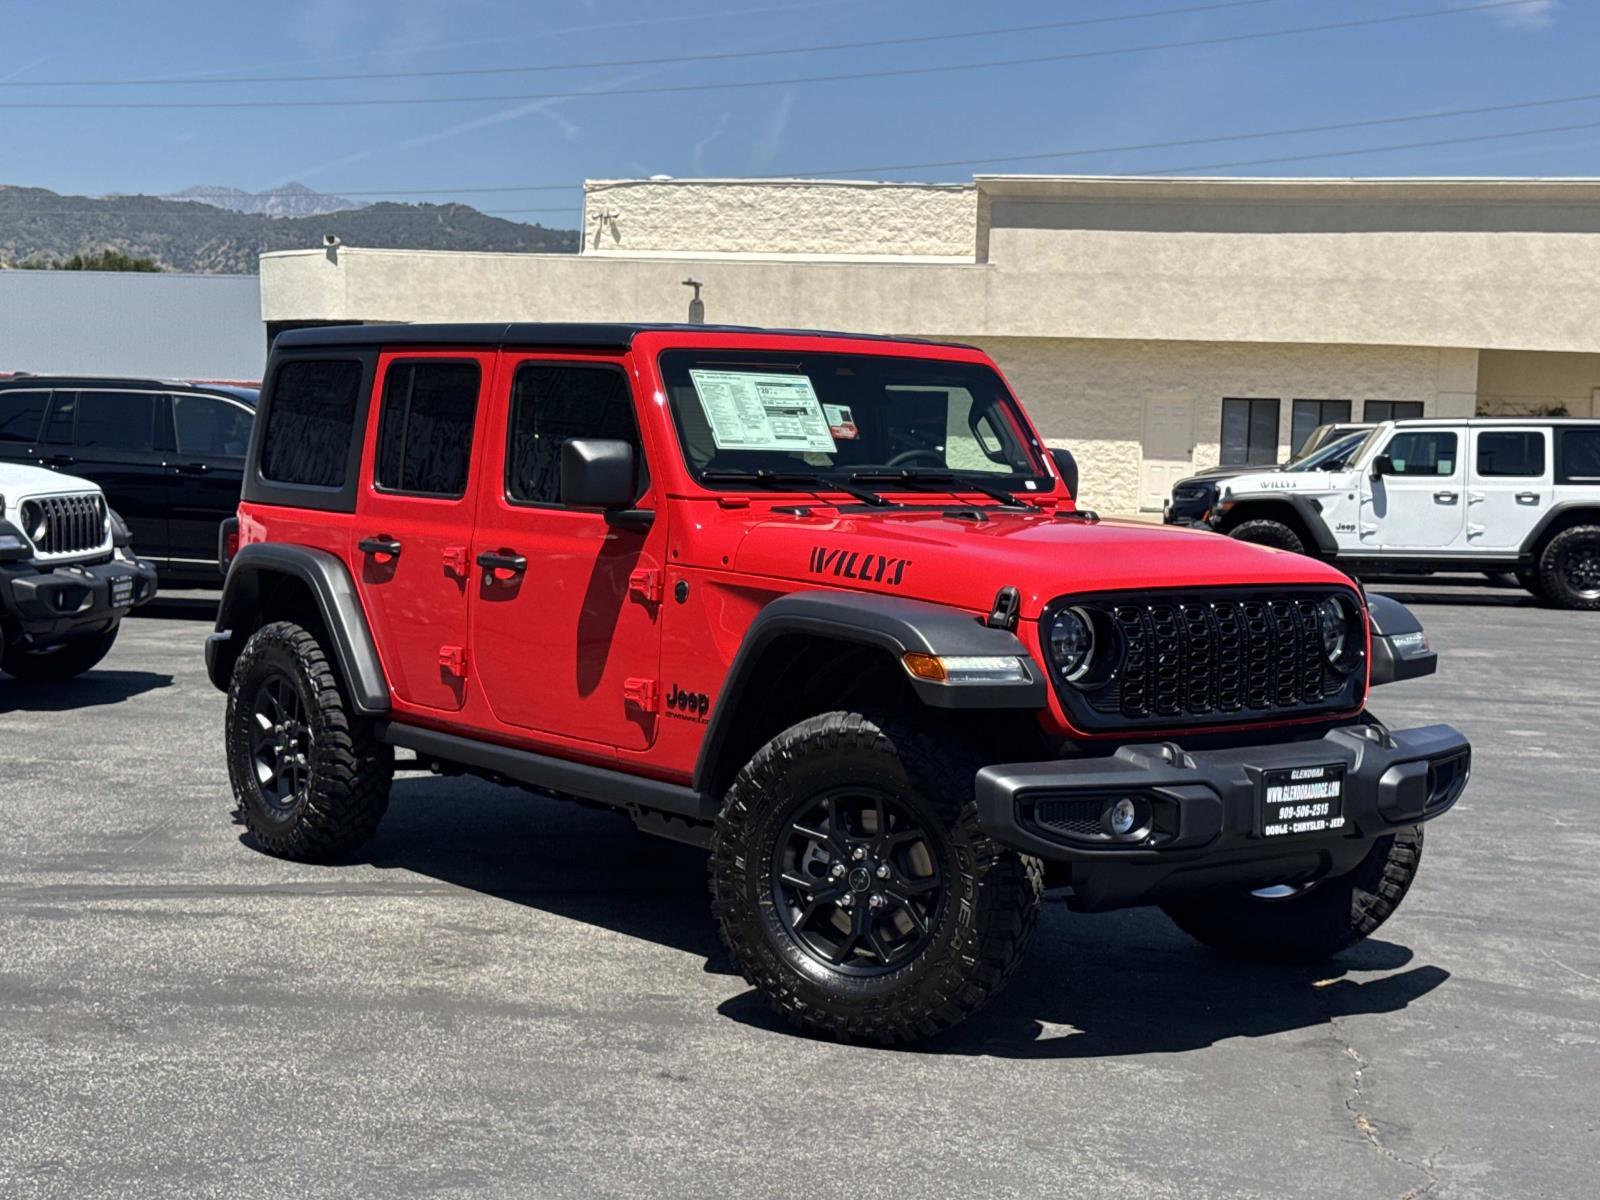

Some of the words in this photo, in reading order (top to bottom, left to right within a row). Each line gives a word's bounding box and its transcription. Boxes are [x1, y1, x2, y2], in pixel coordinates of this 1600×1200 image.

[1335, 522, 1356, 533] Jeep
[809, 546, 912, 585] WILLYS
[666, 683, 709, 720] Jeep
[1290, 768, 1324, 780] GLENDORA
[1279, 803, 1330, 819] 909-506-2515
[1293, 819, 1325, 833] CHRYSLER
[1330, 817, 1345, 829] JEEP
